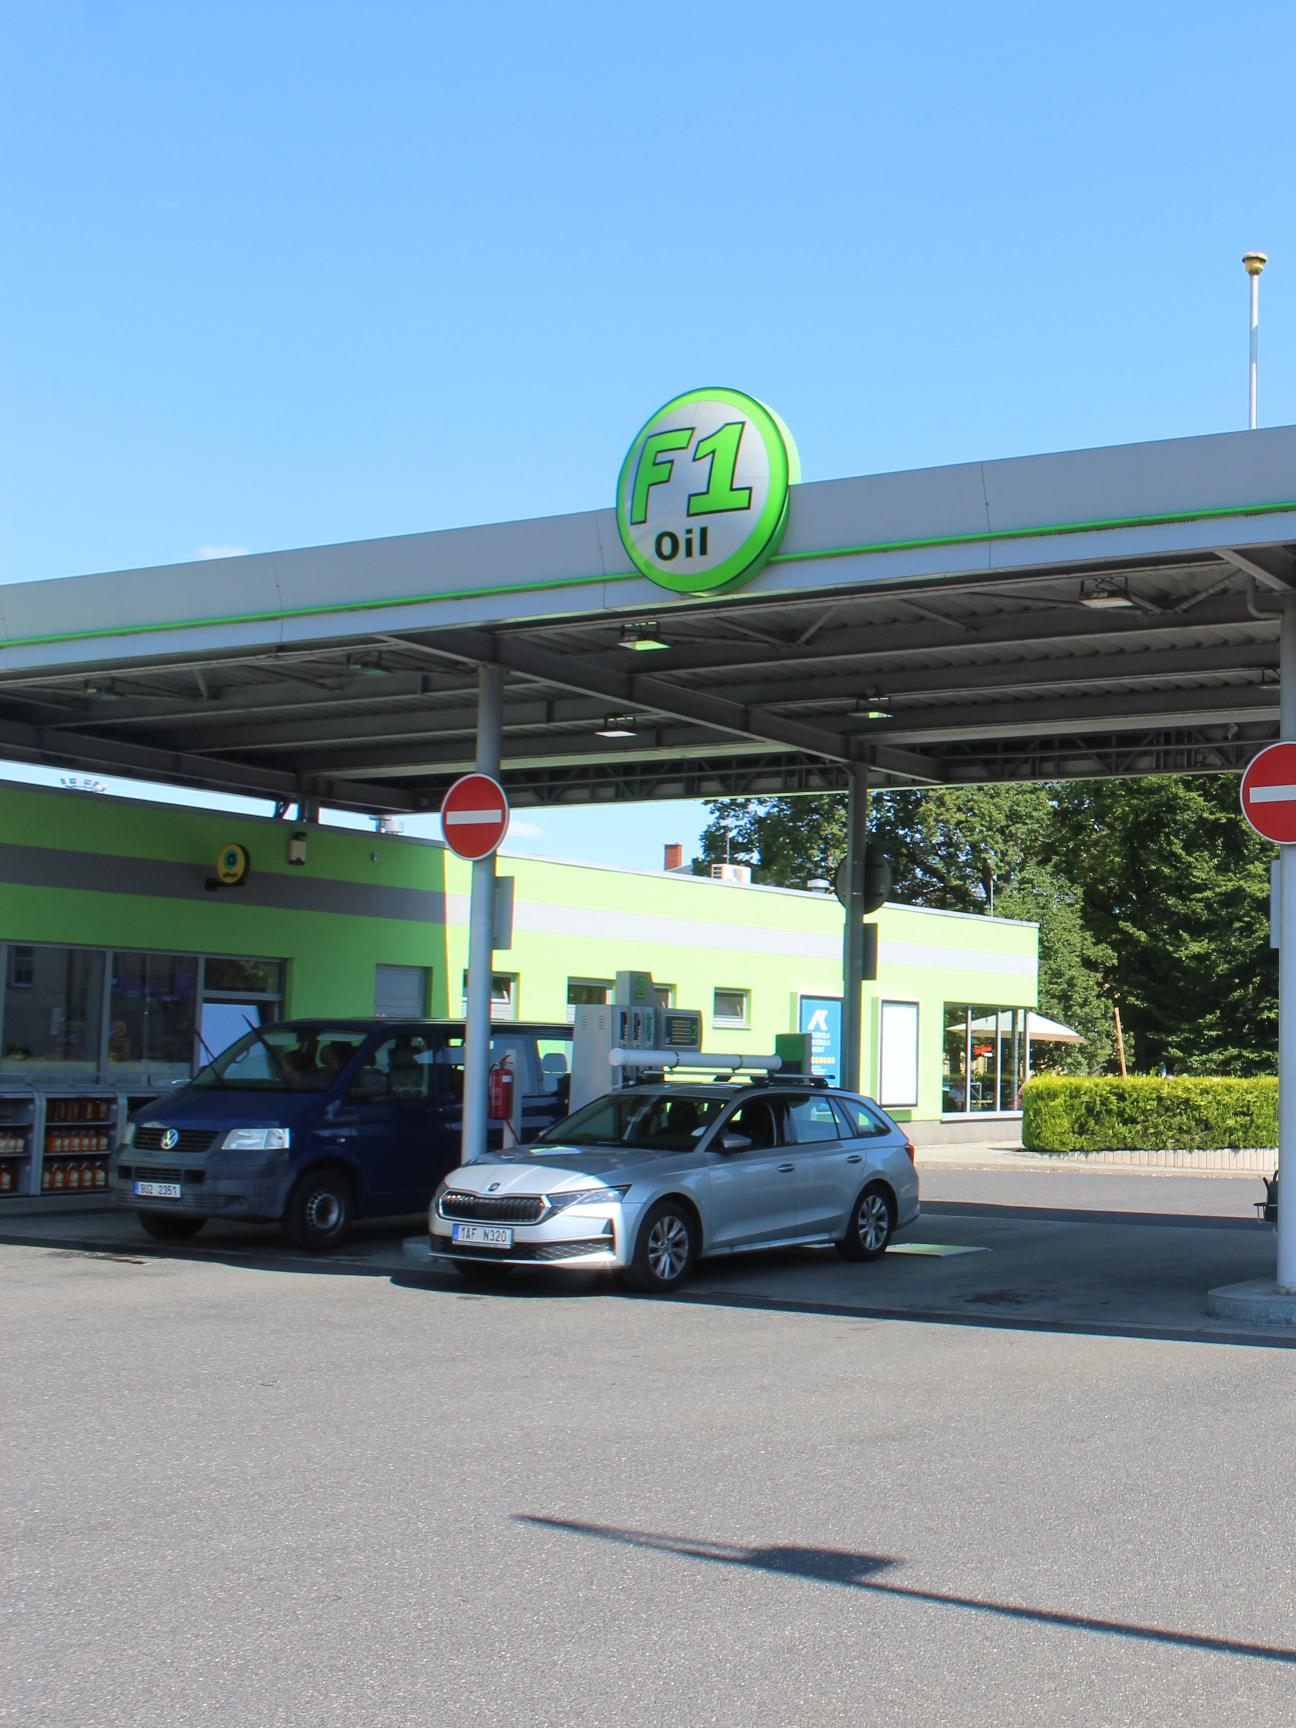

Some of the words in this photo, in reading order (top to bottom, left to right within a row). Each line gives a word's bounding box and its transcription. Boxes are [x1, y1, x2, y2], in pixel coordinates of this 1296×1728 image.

[630, 421, 752, 525] F1
[655, 526, 708, 561] Oil
[634, 975, 648, 1000] 2
[461, 1226, 477, 1240] 1AF
[483, 1229, 507, 1242] N320
